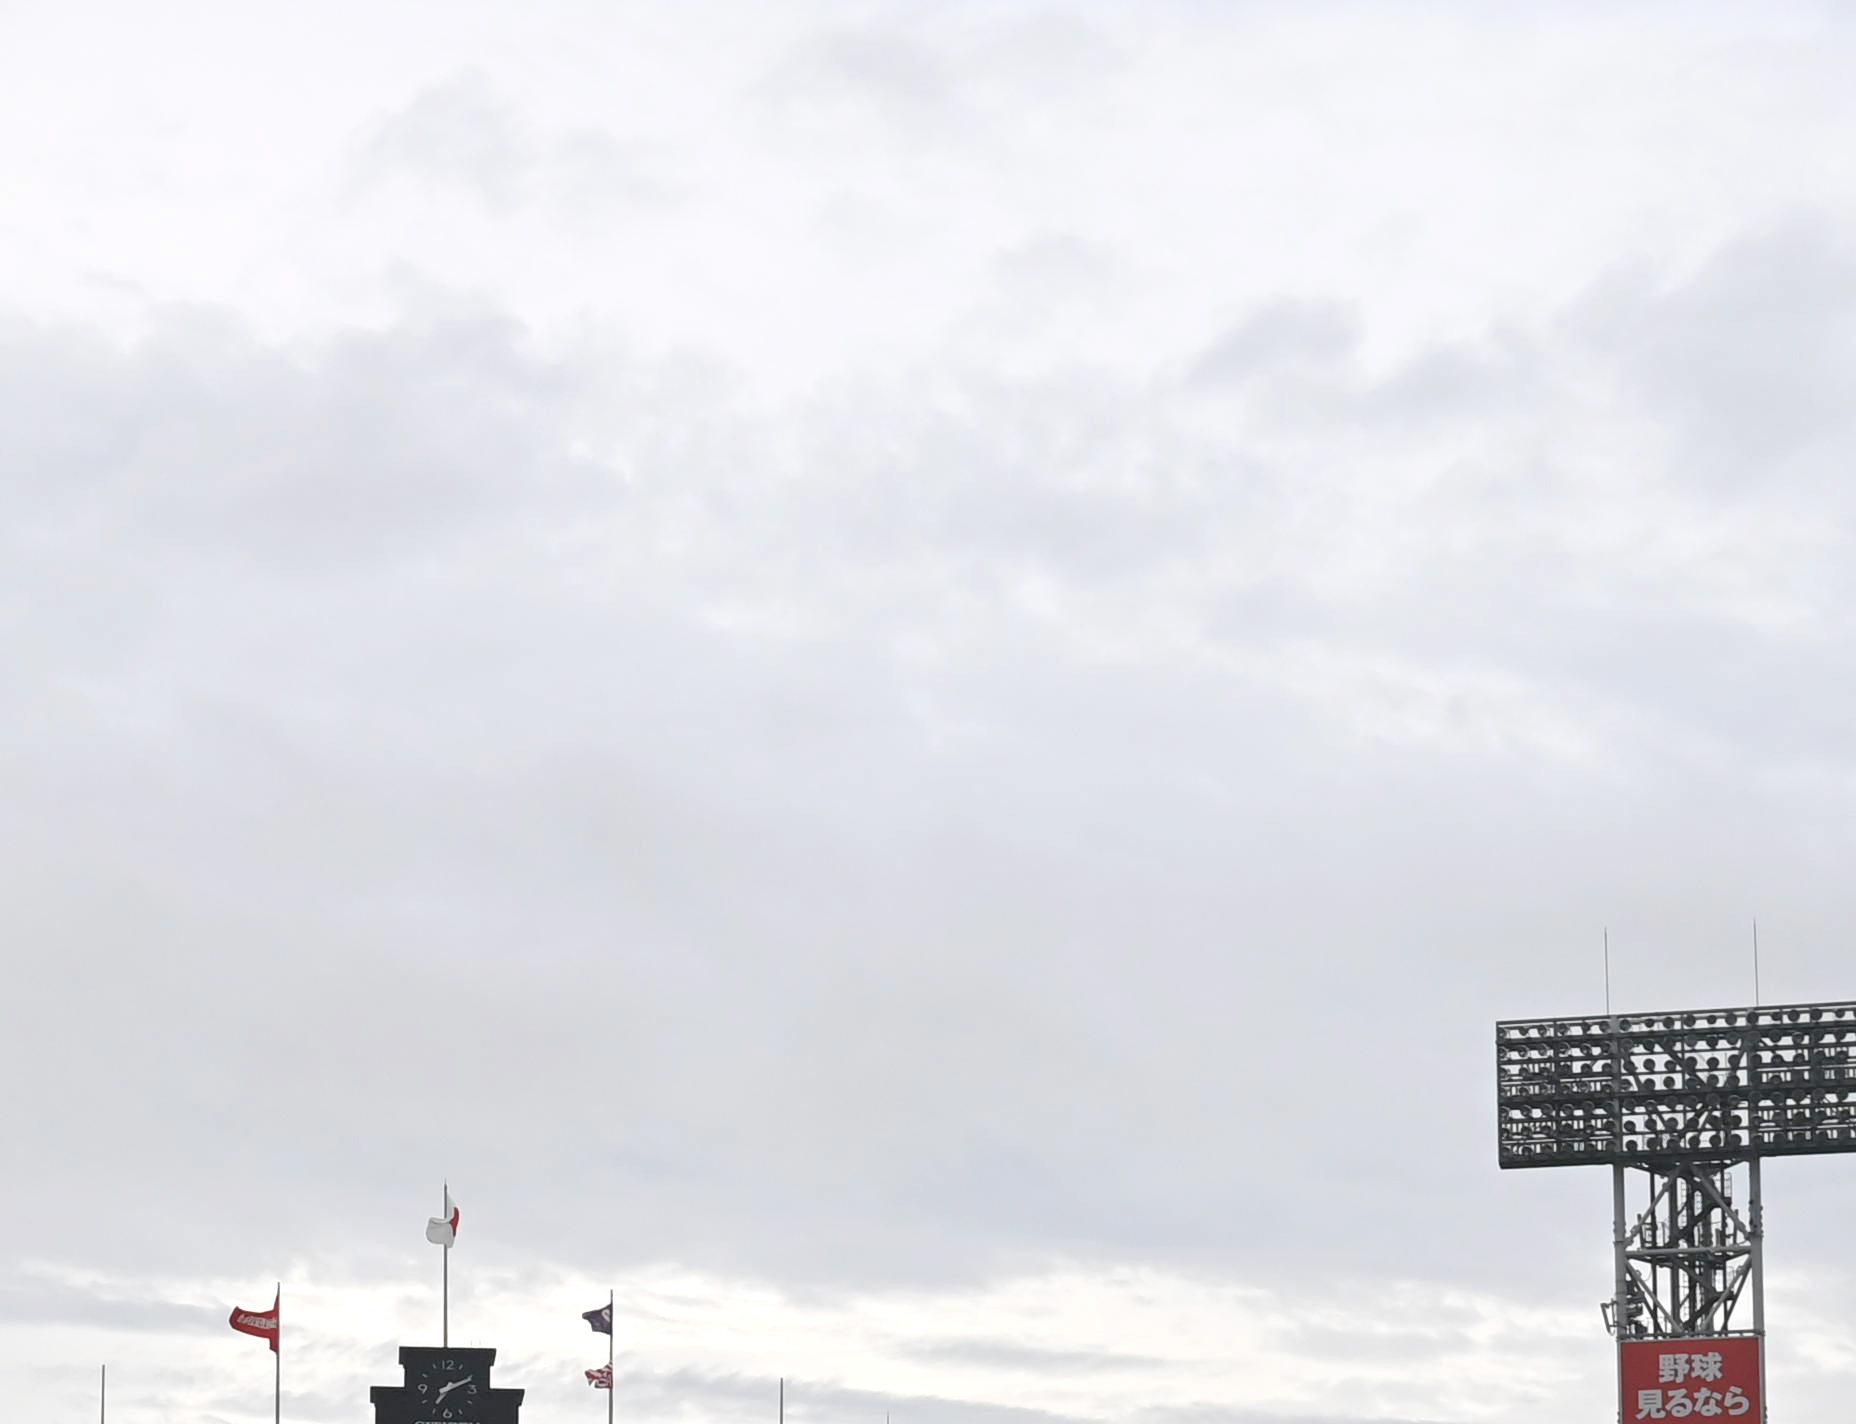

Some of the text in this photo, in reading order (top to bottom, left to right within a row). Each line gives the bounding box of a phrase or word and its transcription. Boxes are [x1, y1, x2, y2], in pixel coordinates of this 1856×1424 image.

[442, 1359, 455, 1371] 12
[1658, 1352, 1723, 1383] 野球
[417, 1383, 428, 1394] 9
[467, 1383, 478, 1395] 3
[1635, 1386, 1750, 1420] 見るなら
[442, 1407, 453, 1419] 6
